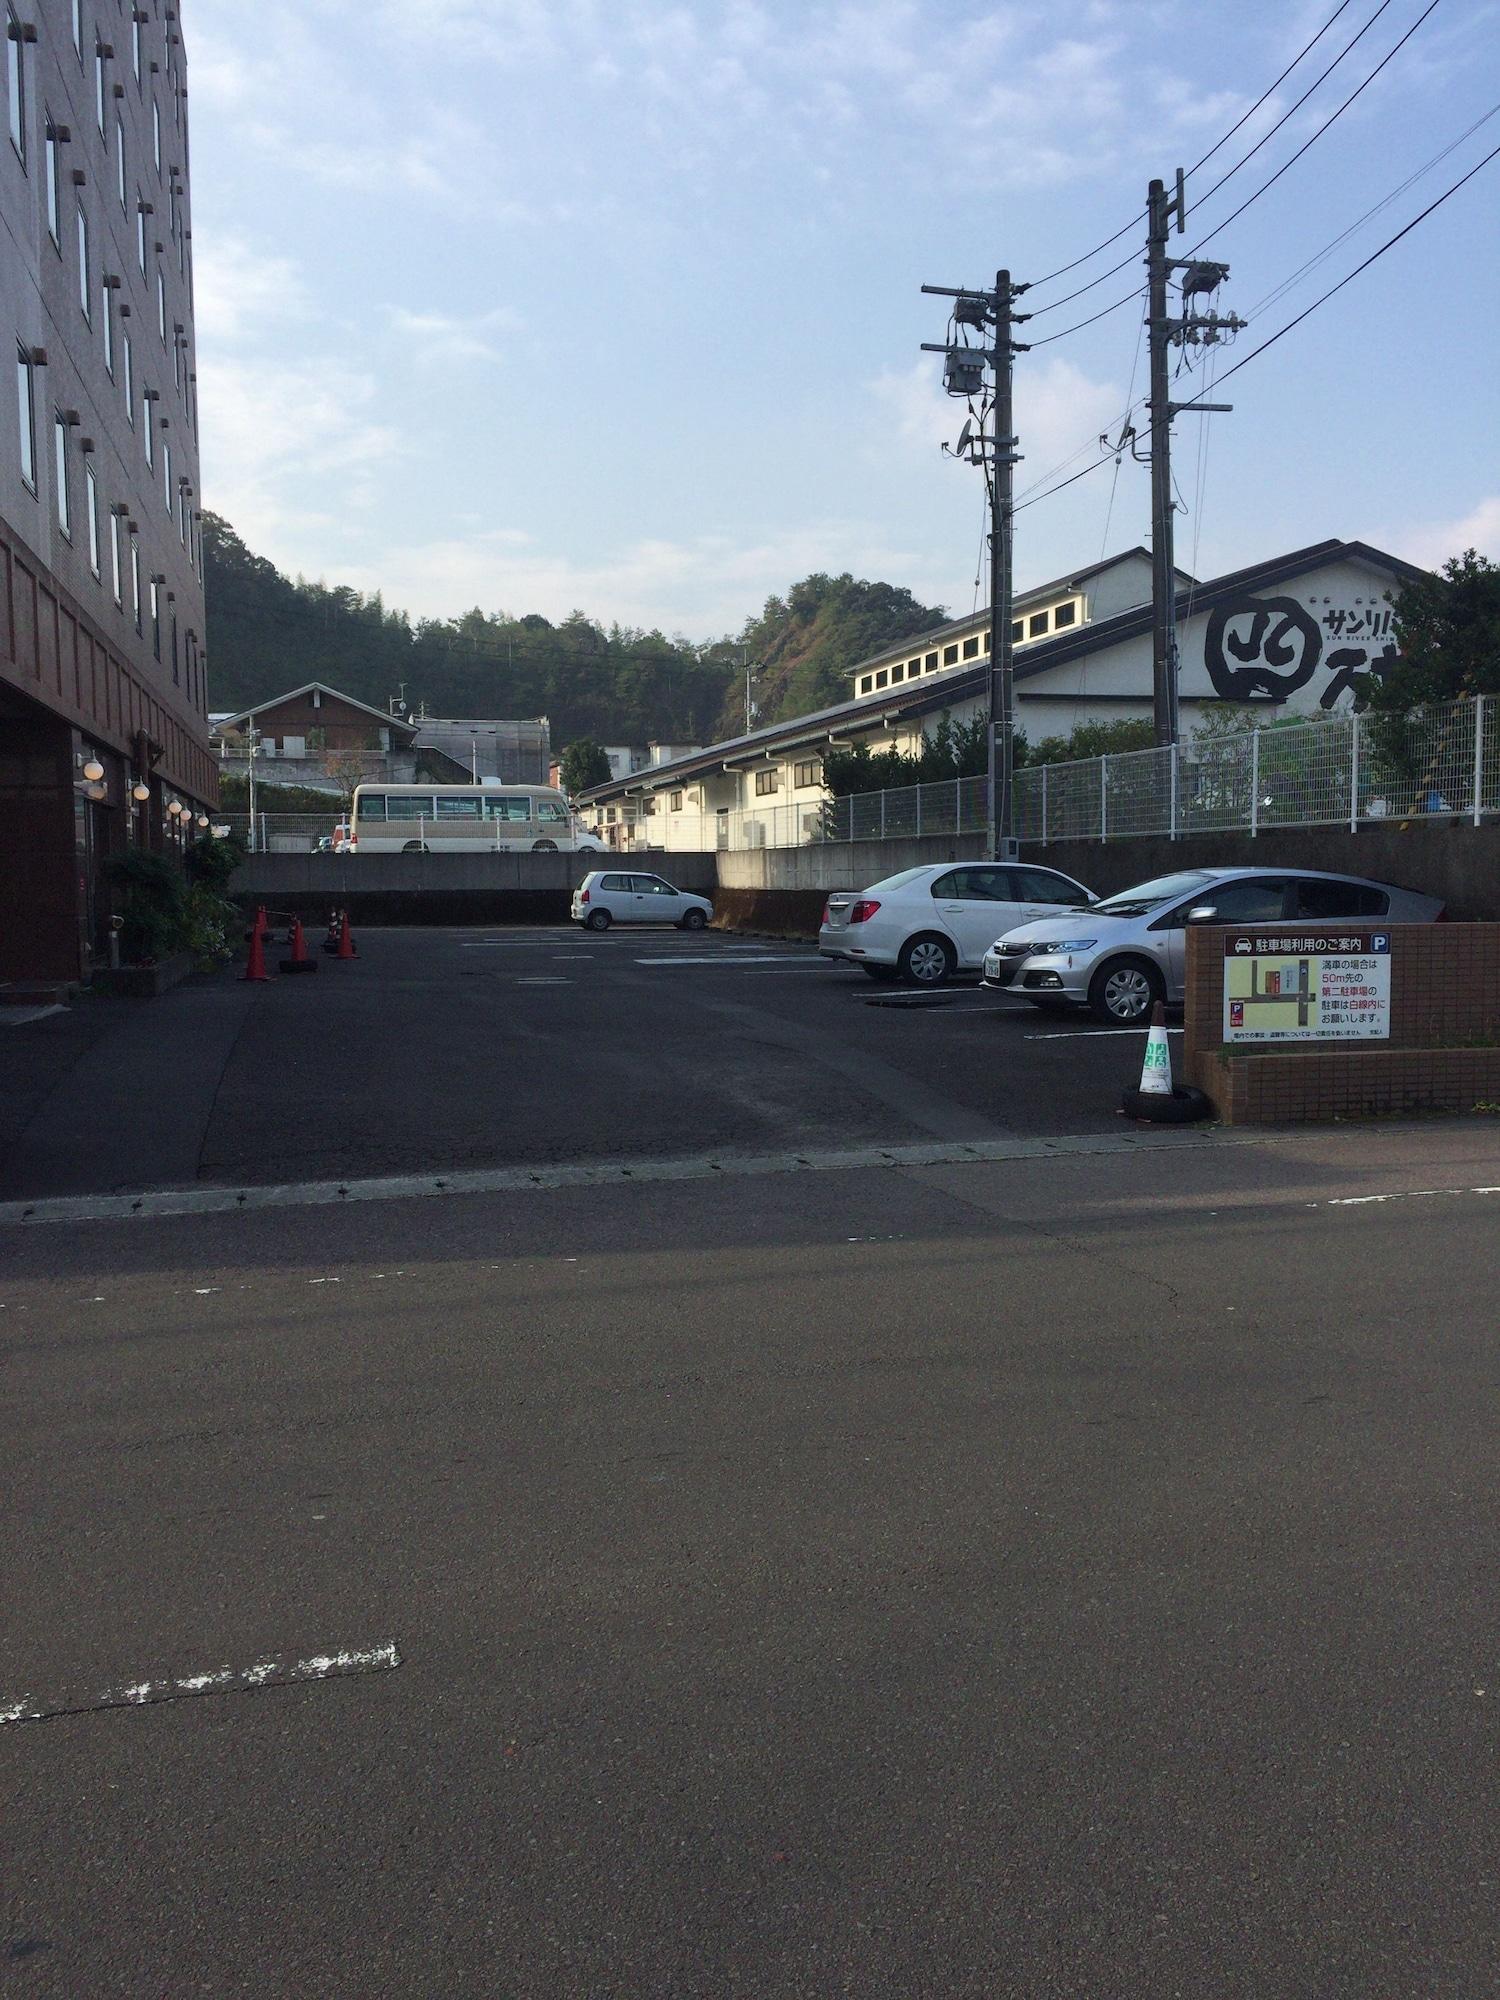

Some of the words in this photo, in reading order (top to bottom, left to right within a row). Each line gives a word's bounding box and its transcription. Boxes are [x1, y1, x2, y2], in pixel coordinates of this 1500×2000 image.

[1255, 937, 1362, 953] 駐車場利用のご案内
[1321, 959, 1377, 970] 満車の場合は
[1321, 973, 1364, 983] 50m先の
[1321, 986, 1378, 997] 第二駐車場の
[1321, 999, 1386, 1011] 駐車は白線内に
[1321, 1013, 1381, 1024] お願いします。
